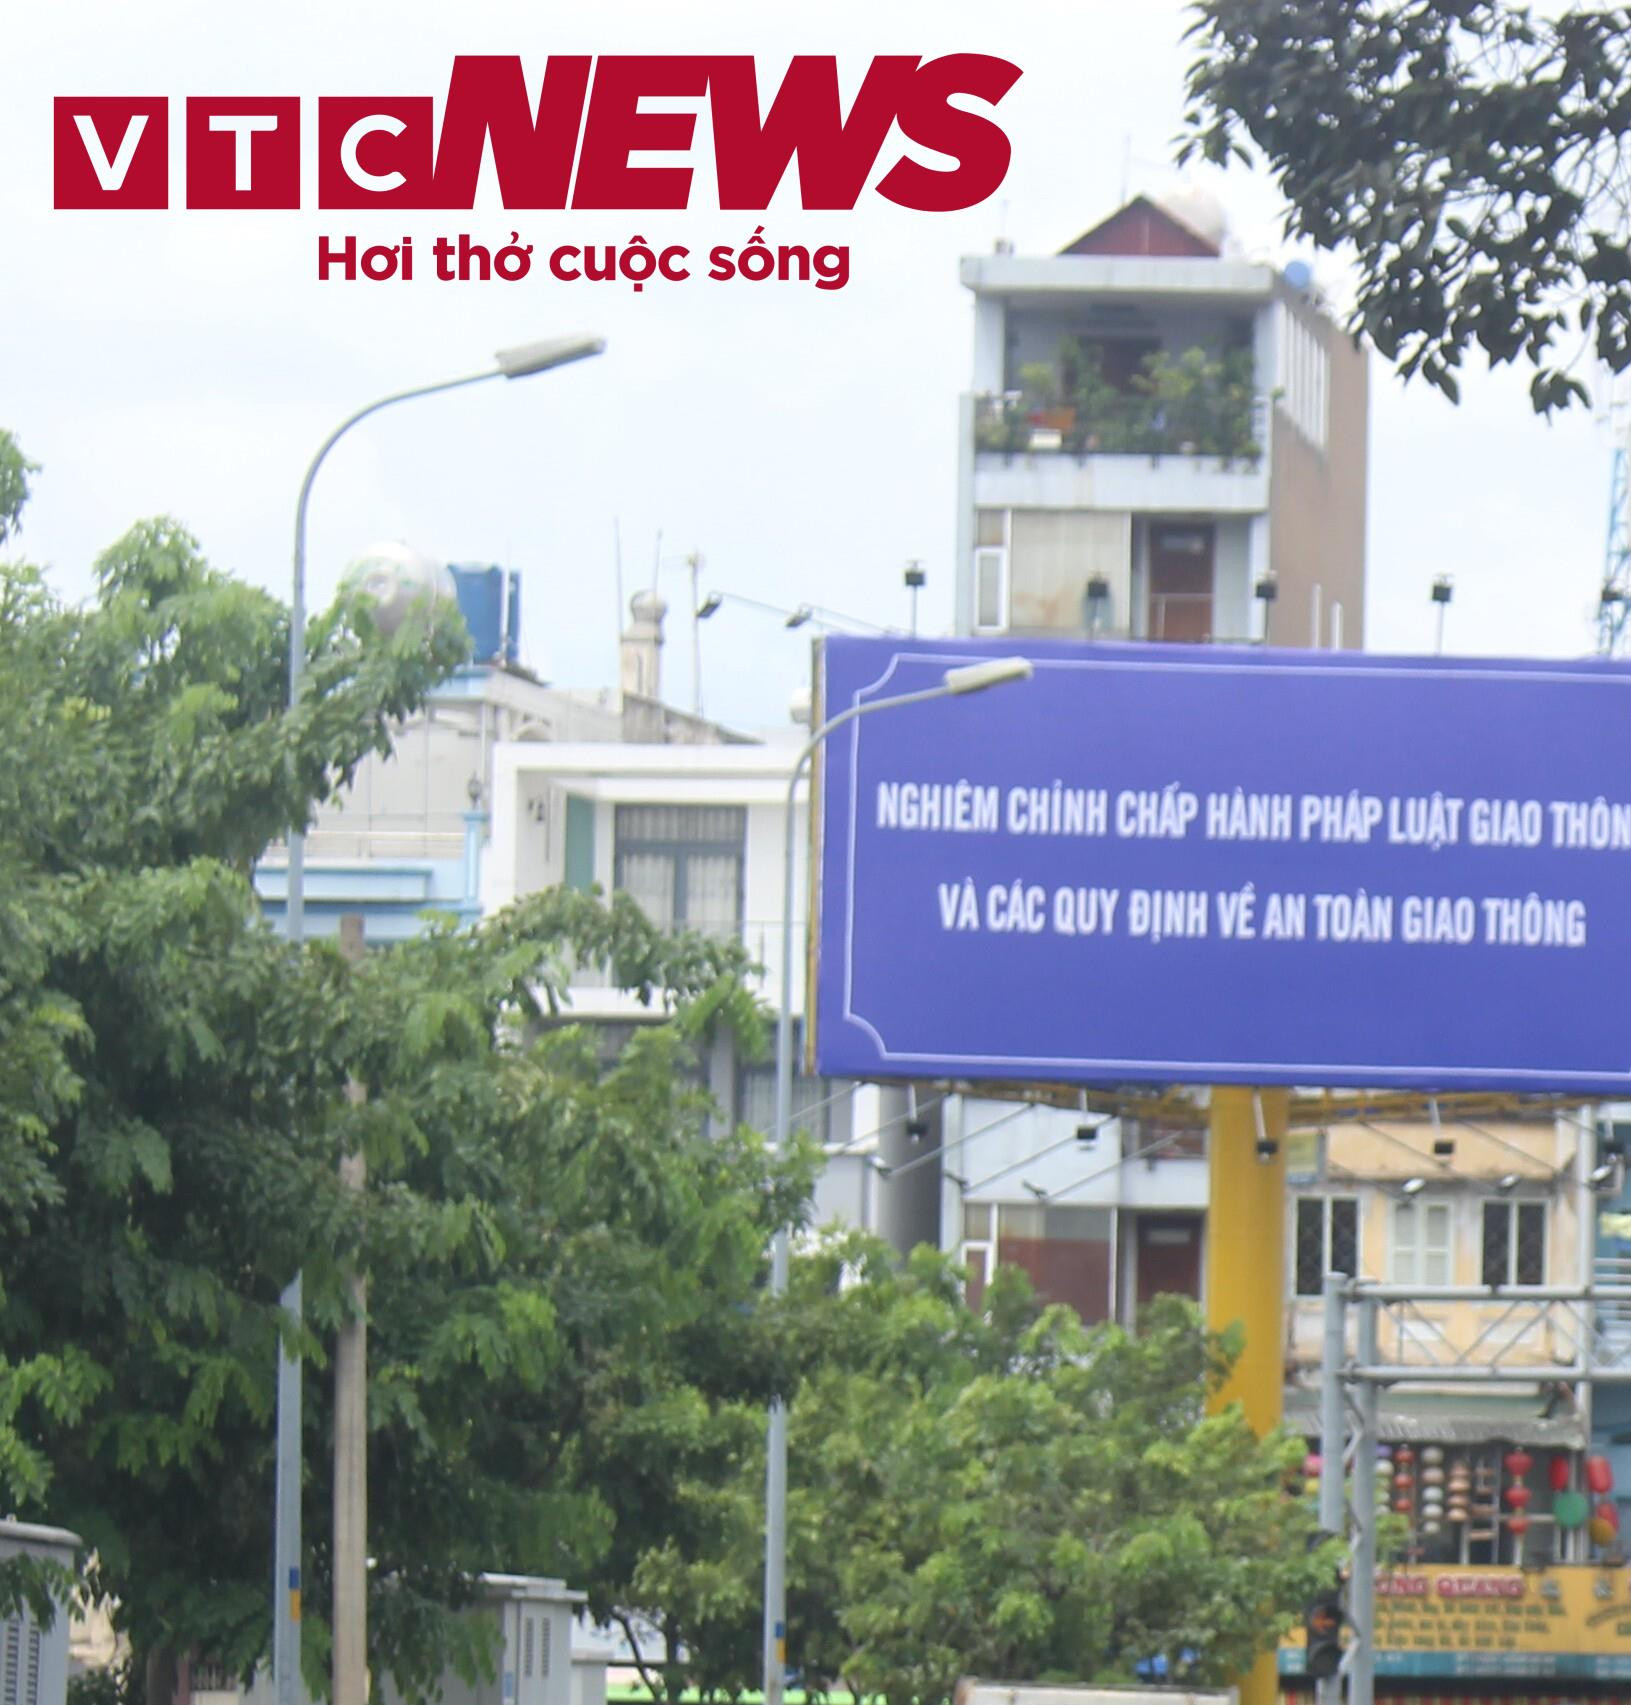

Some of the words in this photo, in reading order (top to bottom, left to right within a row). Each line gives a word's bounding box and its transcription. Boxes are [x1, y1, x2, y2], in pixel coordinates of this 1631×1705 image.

[875, 777, 1000, 833] NGHIÊM
[1114, 780, 1200, 839] CHẤP
[1205, 785, 1293, 841] HÀNH
[1298, 788, 1384, 843] PHÁP
[1387, 790, 1466, 850] LUẬT
[1468, 797, 1544, 848] GIAO
[937, 875, 981, 931] VÀ
[985, 877, 1047, 934] CÁC
[1052, 886, 1120, 936] QUY
[1127, 888, 1209, 943] ĐỊNH
[1216, 881, 1257, 940] VỀ
[1261, 892, 1307, 940] AN
[1312, 887, 1394, 943] TOÀN
[1400, 895, 1476, 945] GIAO
[1481, 891, 1587, 948] THÔNG
